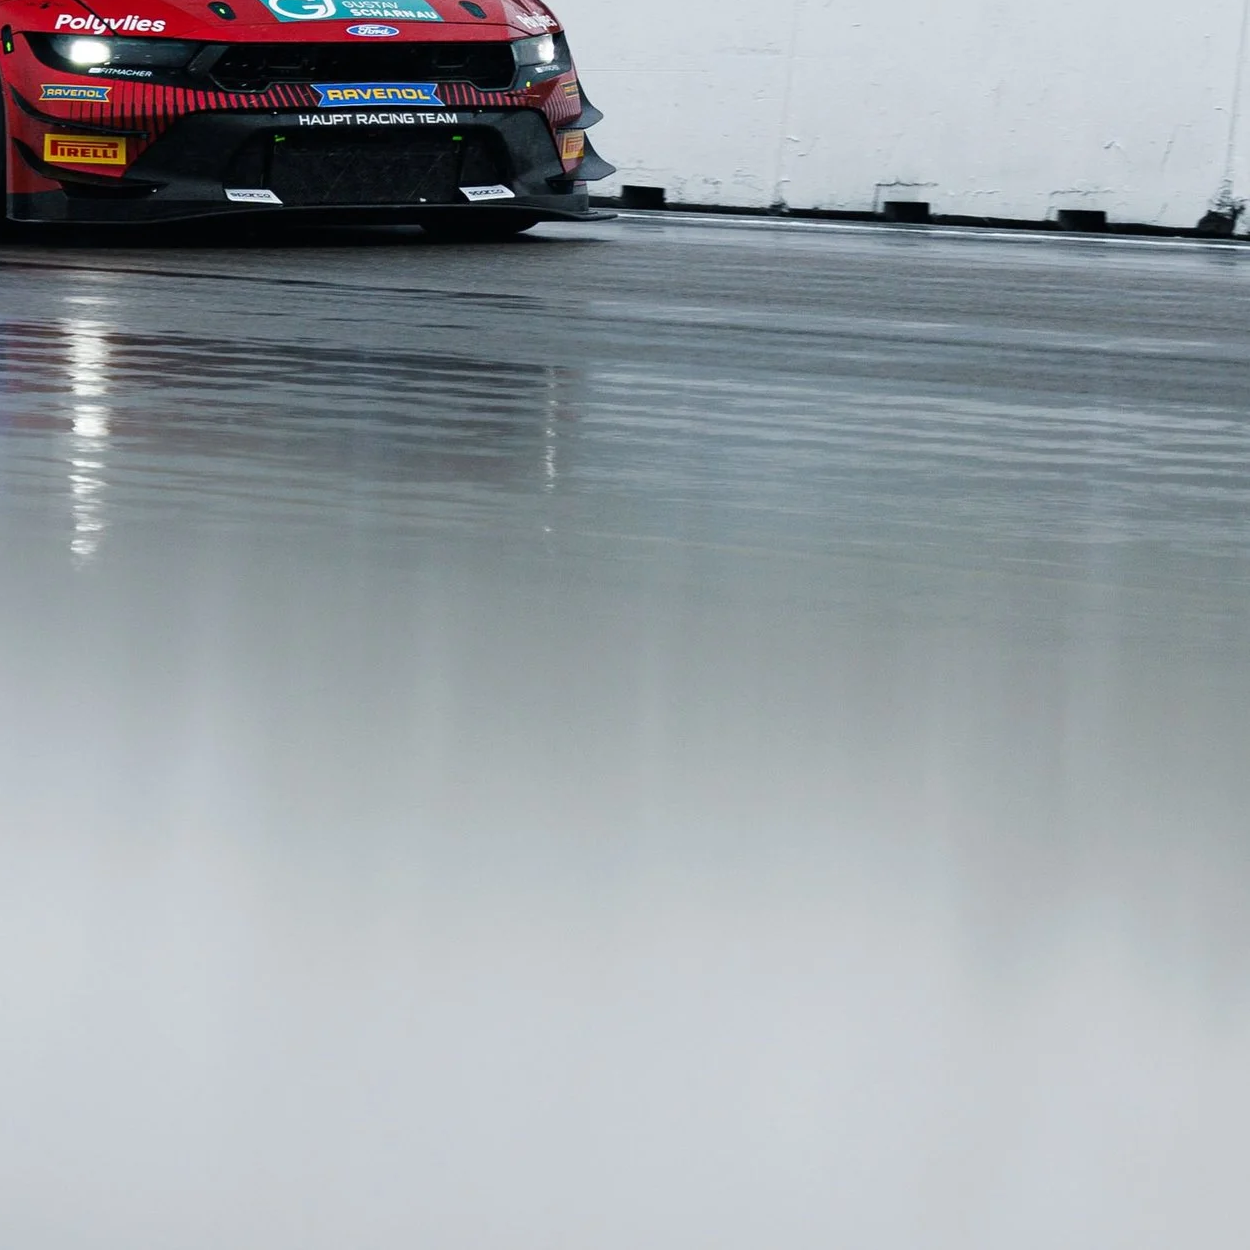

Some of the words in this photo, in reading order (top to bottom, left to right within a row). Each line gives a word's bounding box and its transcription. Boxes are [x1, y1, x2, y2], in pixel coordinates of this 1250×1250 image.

[342, 0, 399, 10] GUSTAV
[350, 8, 438, 20] SCHARNAU
[54, 14, 166, 35] Polyvlies
[357, 24, 390, 36] Ford
[46, 88, 103, 98] RAVENOL
[327, 88, 431, 100] RAVENOL
[299, 114, 352, 126] HAUPT
[356, 113, 415, 125] RACING
[416, 112, 458, 124] TEAM
[50, 139, 119, 159] PIRELLI
